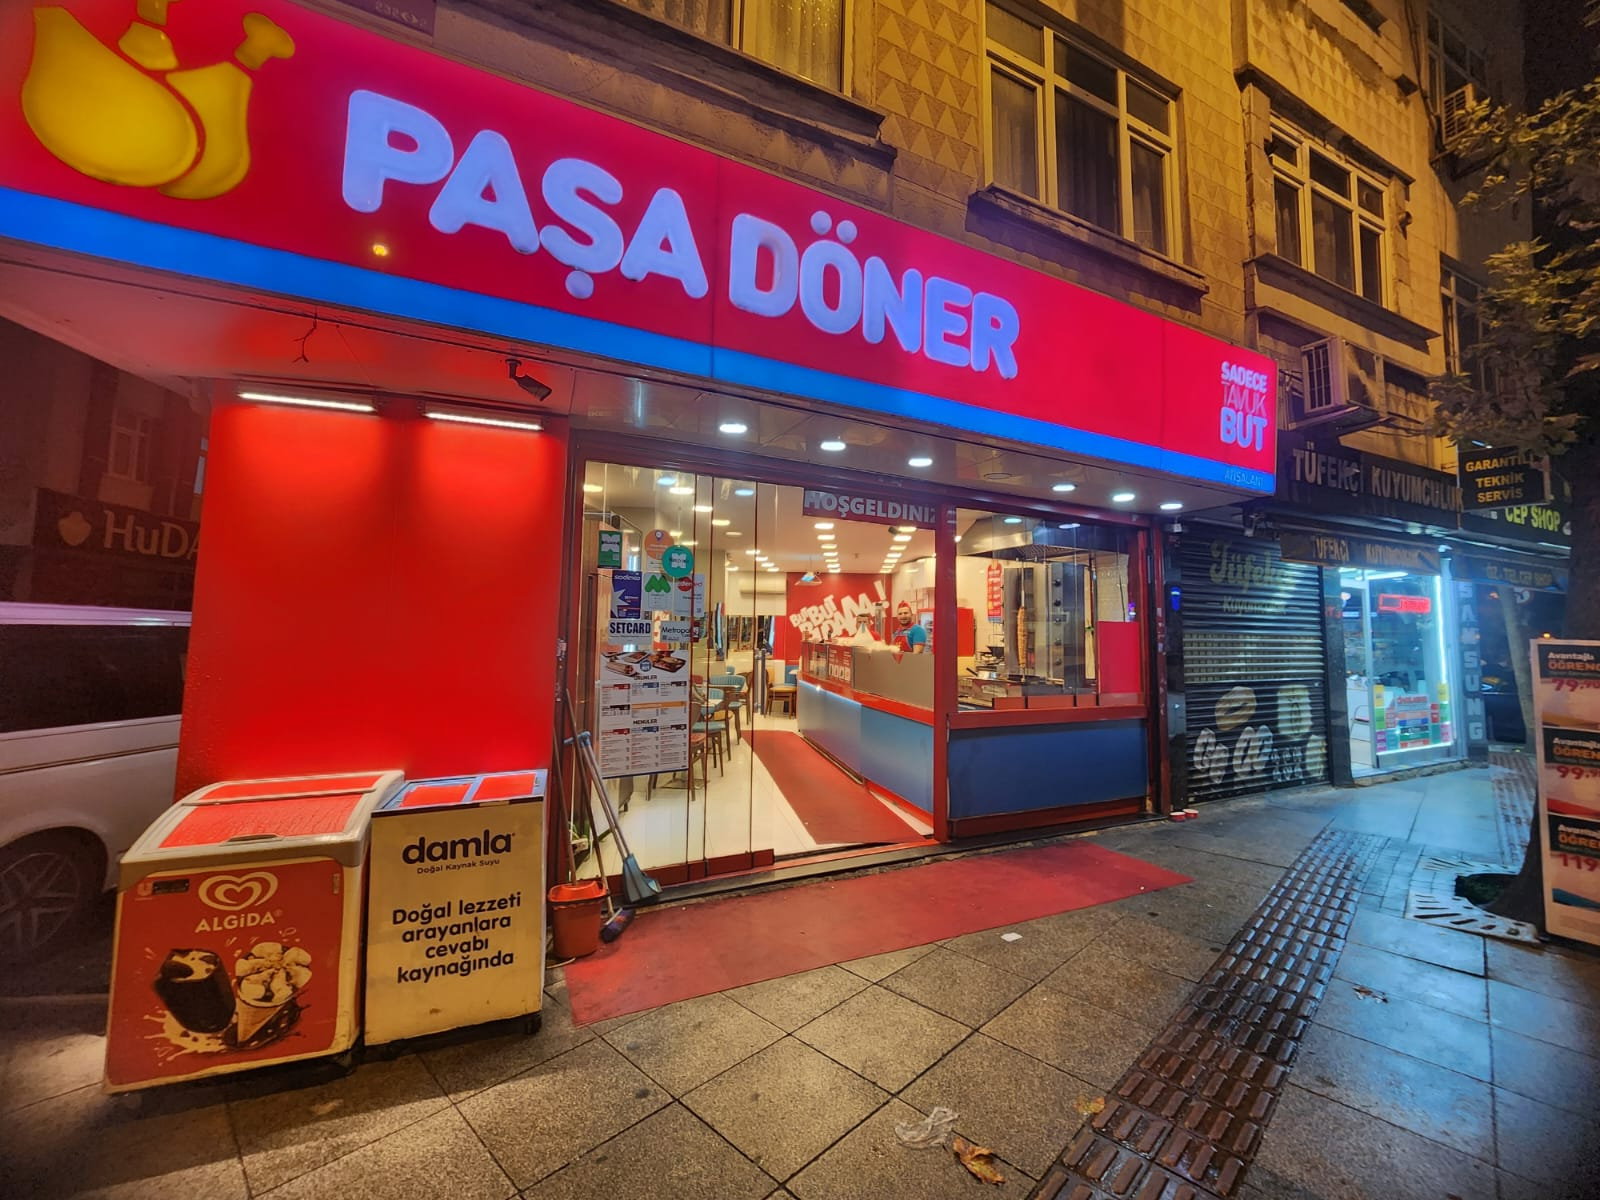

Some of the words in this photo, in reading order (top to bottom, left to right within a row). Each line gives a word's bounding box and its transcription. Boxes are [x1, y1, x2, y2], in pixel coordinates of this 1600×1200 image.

[342, 89, 709, 299] PAŞA
[728, 210, 1020, 380] DÖNER
[1221, 361, 1267, 393] SADECE
[1221, 381, 1267, 418] TAVUK
[1220, 406, 1268, 451] BUT
[1475, 471, 1525, 489] TEKNİK
[1477, 487, 1524, 503] SERVİS
[1505, 505, 1528, 525] CEP
[1531, 504, 1561, 532] SHOP
[609, 622, 651, 634] SETCARD
[661, 626, 691, 635] Metropo
[1458, 582, 1484, 740] SAMSUNG
[402, 829, 512, 865] damla
[417, 864, 443, 875] Doğal
[446, 860, 477, 872] Kaynak
[479, 859, 500, 868] Suyu
[393, 902, 451, 926] Doğal
[459, 891, 521, 915] lezzeti
[402, 914, 512, 943] arayanlara
[425, 936, 488, 959] cevabı
[397, 951, 514, 984] kaynağında
